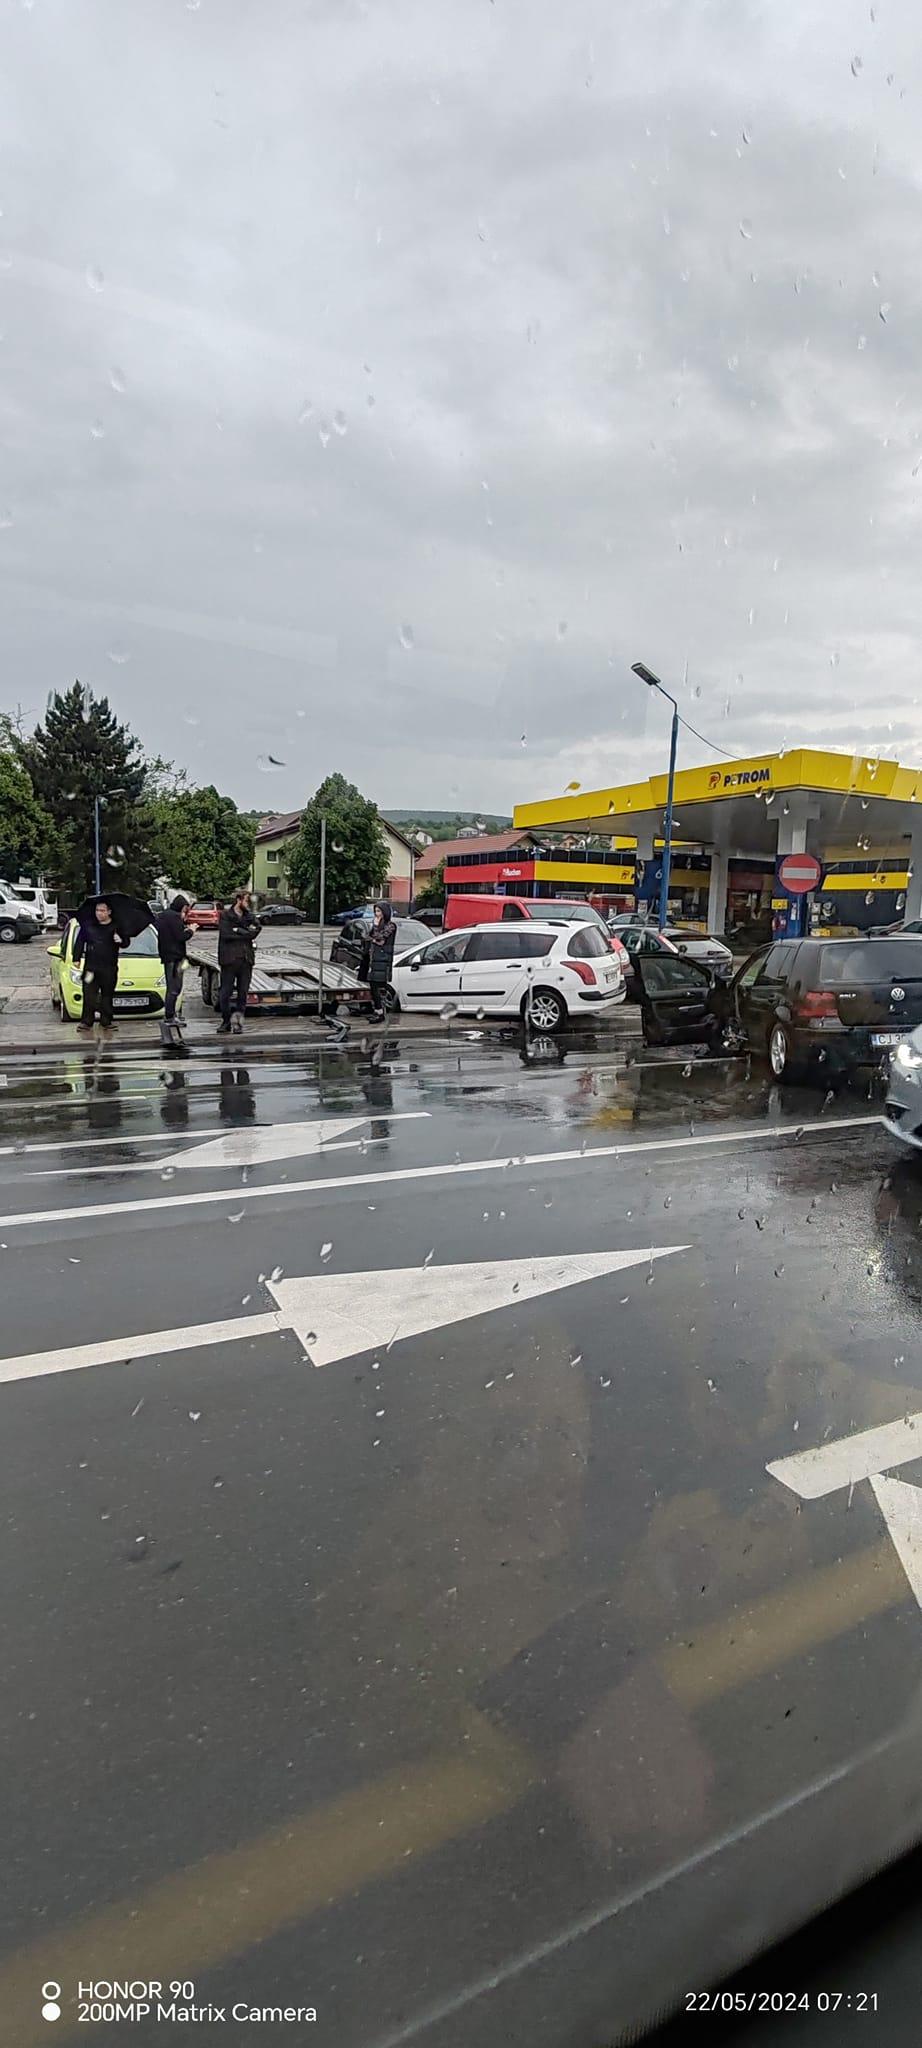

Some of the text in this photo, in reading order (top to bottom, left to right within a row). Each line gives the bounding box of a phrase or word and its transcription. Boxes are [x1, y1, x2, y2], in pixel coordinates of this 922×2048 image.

[724, 768, 770, 787] PETROM
[655, 868, 663, 880] 6
[878, 1034, 892, 1044] CJ
